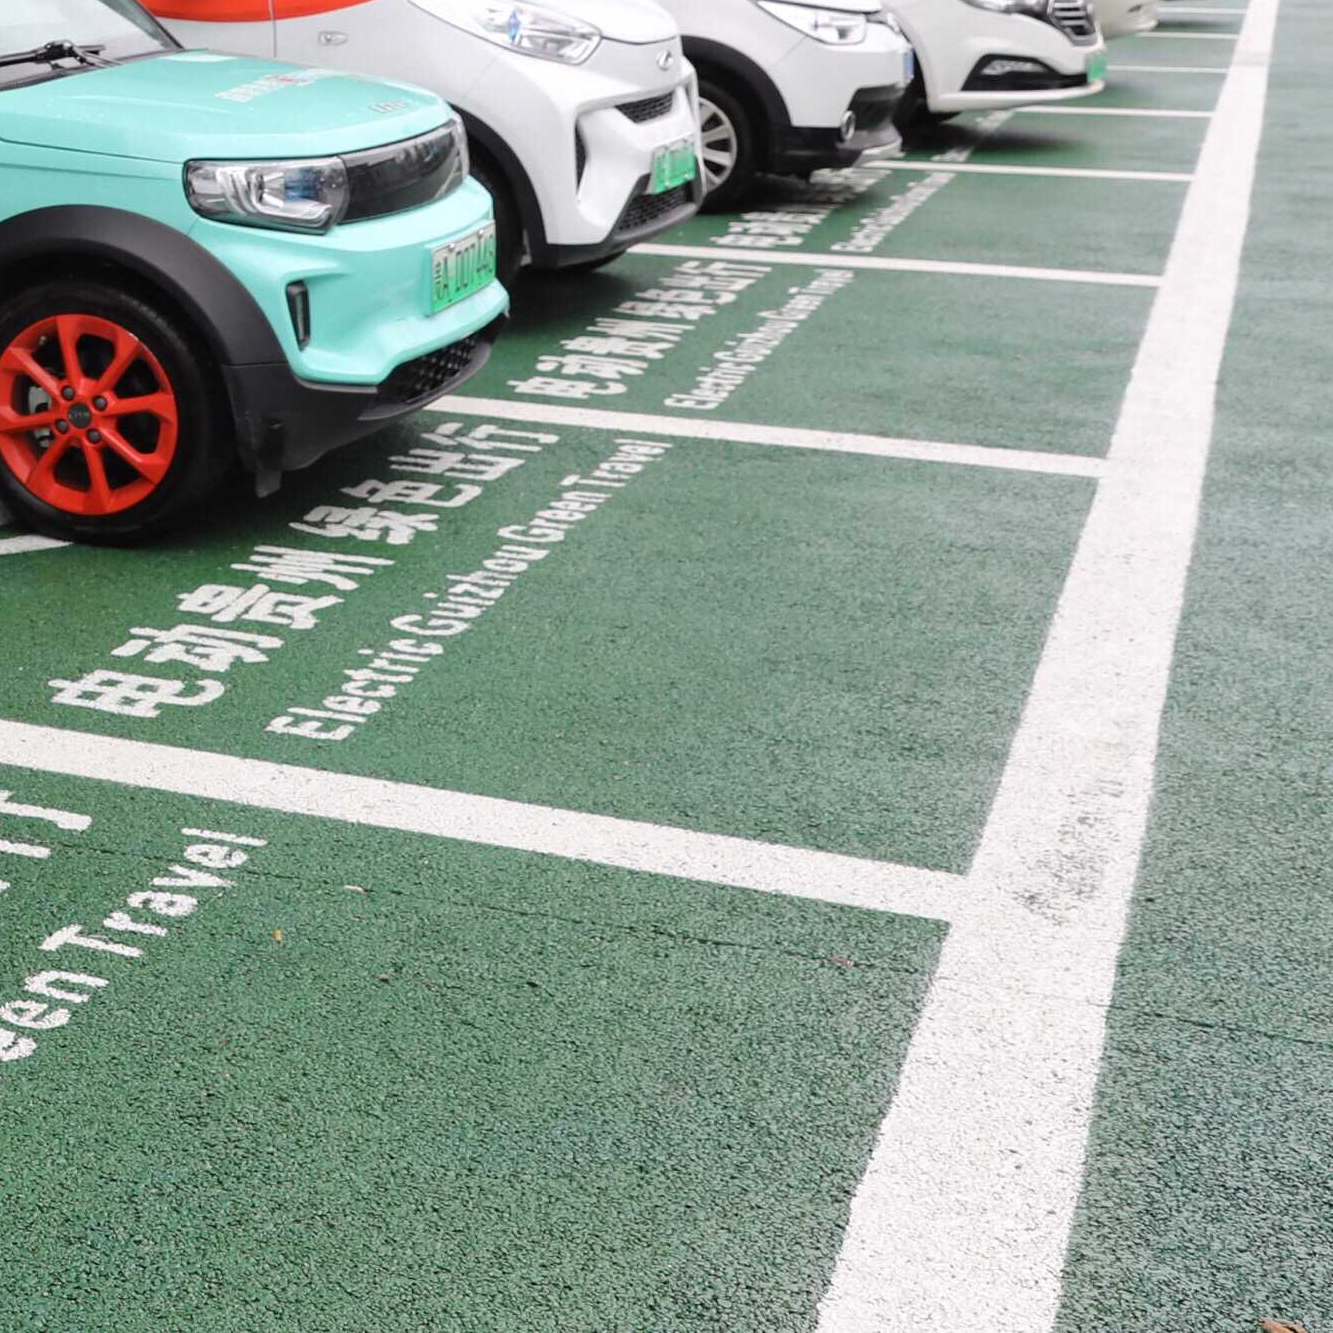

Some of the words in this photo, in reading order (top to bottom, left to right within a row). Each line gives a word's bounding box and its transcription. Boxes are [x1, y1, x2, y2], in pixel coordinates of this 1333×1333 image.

[506, 316, 697, 400] 电动贵州
[27, 539, 396, 720] 电动贵州
[289, 421, 561, 546] 绿色出行
[264, 639, 445, 742] Electric
[389, 541, 550, 638] Guizhou
[497, 487, 610, 544] Green
[561, 438, 674, 489] Travel
[41, 826, 269, 959] Travel
